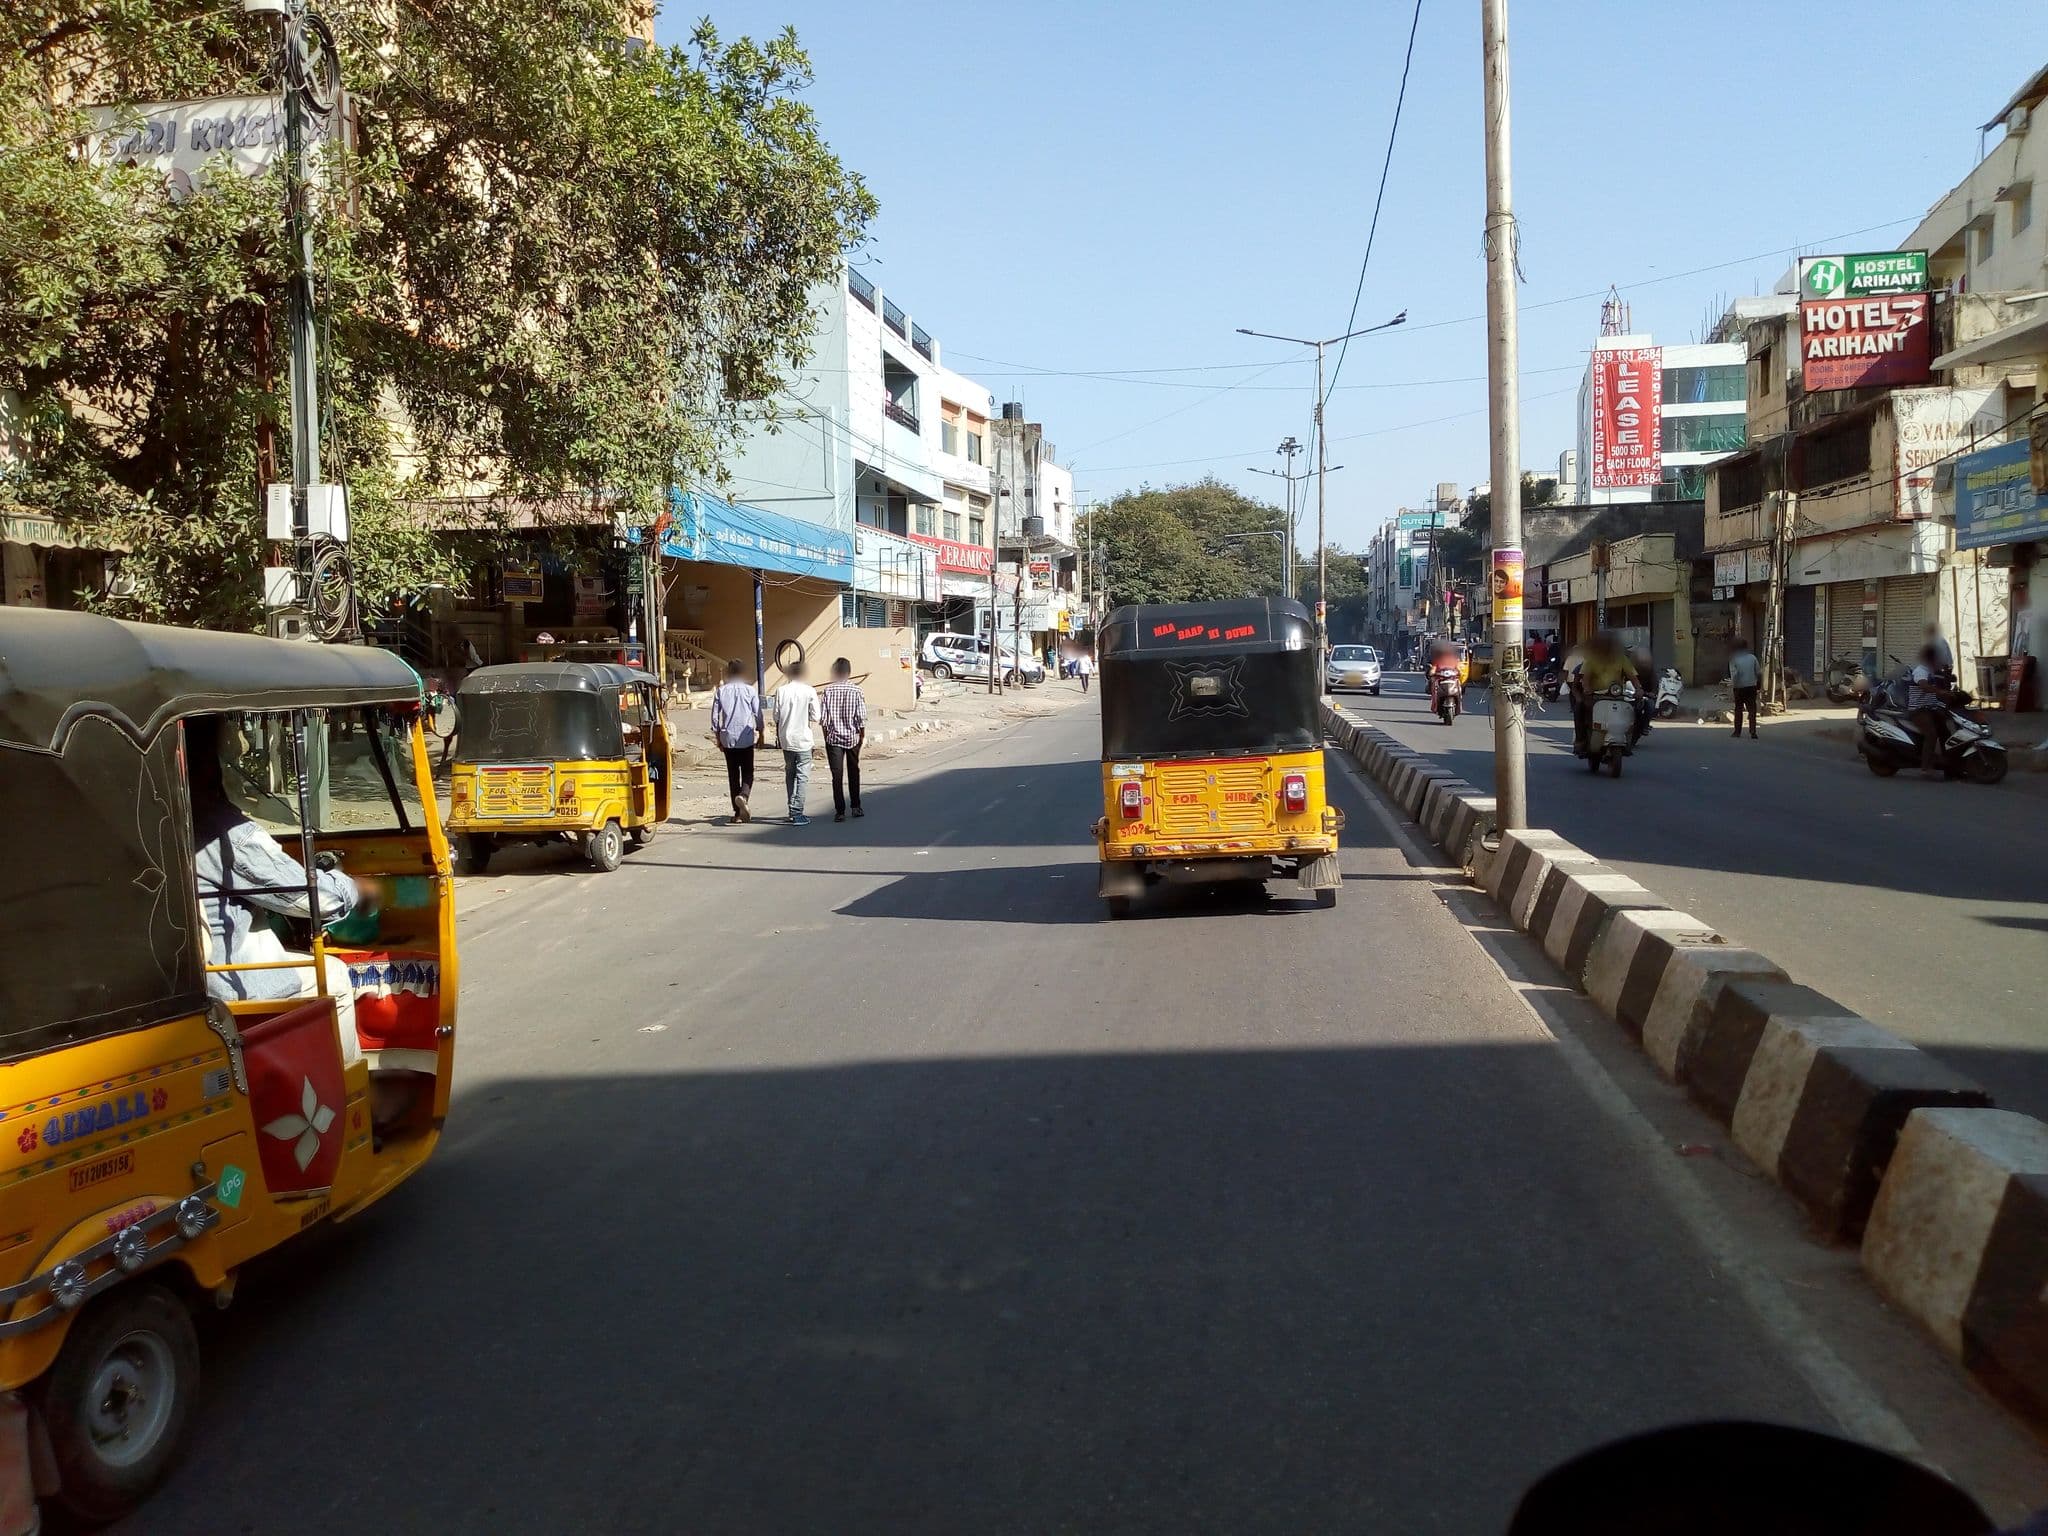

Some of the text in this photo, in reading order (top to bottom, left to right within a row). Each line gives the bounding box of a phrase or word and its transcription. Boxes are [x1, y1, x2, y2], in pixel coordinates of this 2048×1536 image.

[1854, 258, 1917, 274] HOSTEL
[1851, 272, 1923, 288] ARIHANT
[1805, 302, 1898, 332] HOTEL
[1807, 331, 1909, 359] ARIHANT
[1594, 348, 1661, 363] 939 101 2584
[1615, 363, 1642, 444] LEASE
[1611, 444, 1644, 457] 5000 SFT
[1606, 457, 1651, 470] EACH FLOOR
[1594, 473, 1661, 486] 939 101 2584
[939, 544, 991, 571] CERAMICS
[1153, 623, 1255, 640] MAA BAAP KI DUWA
[1172, 794, 1199, 804] FOR
[222, 1174, 241, 1197] LPG
